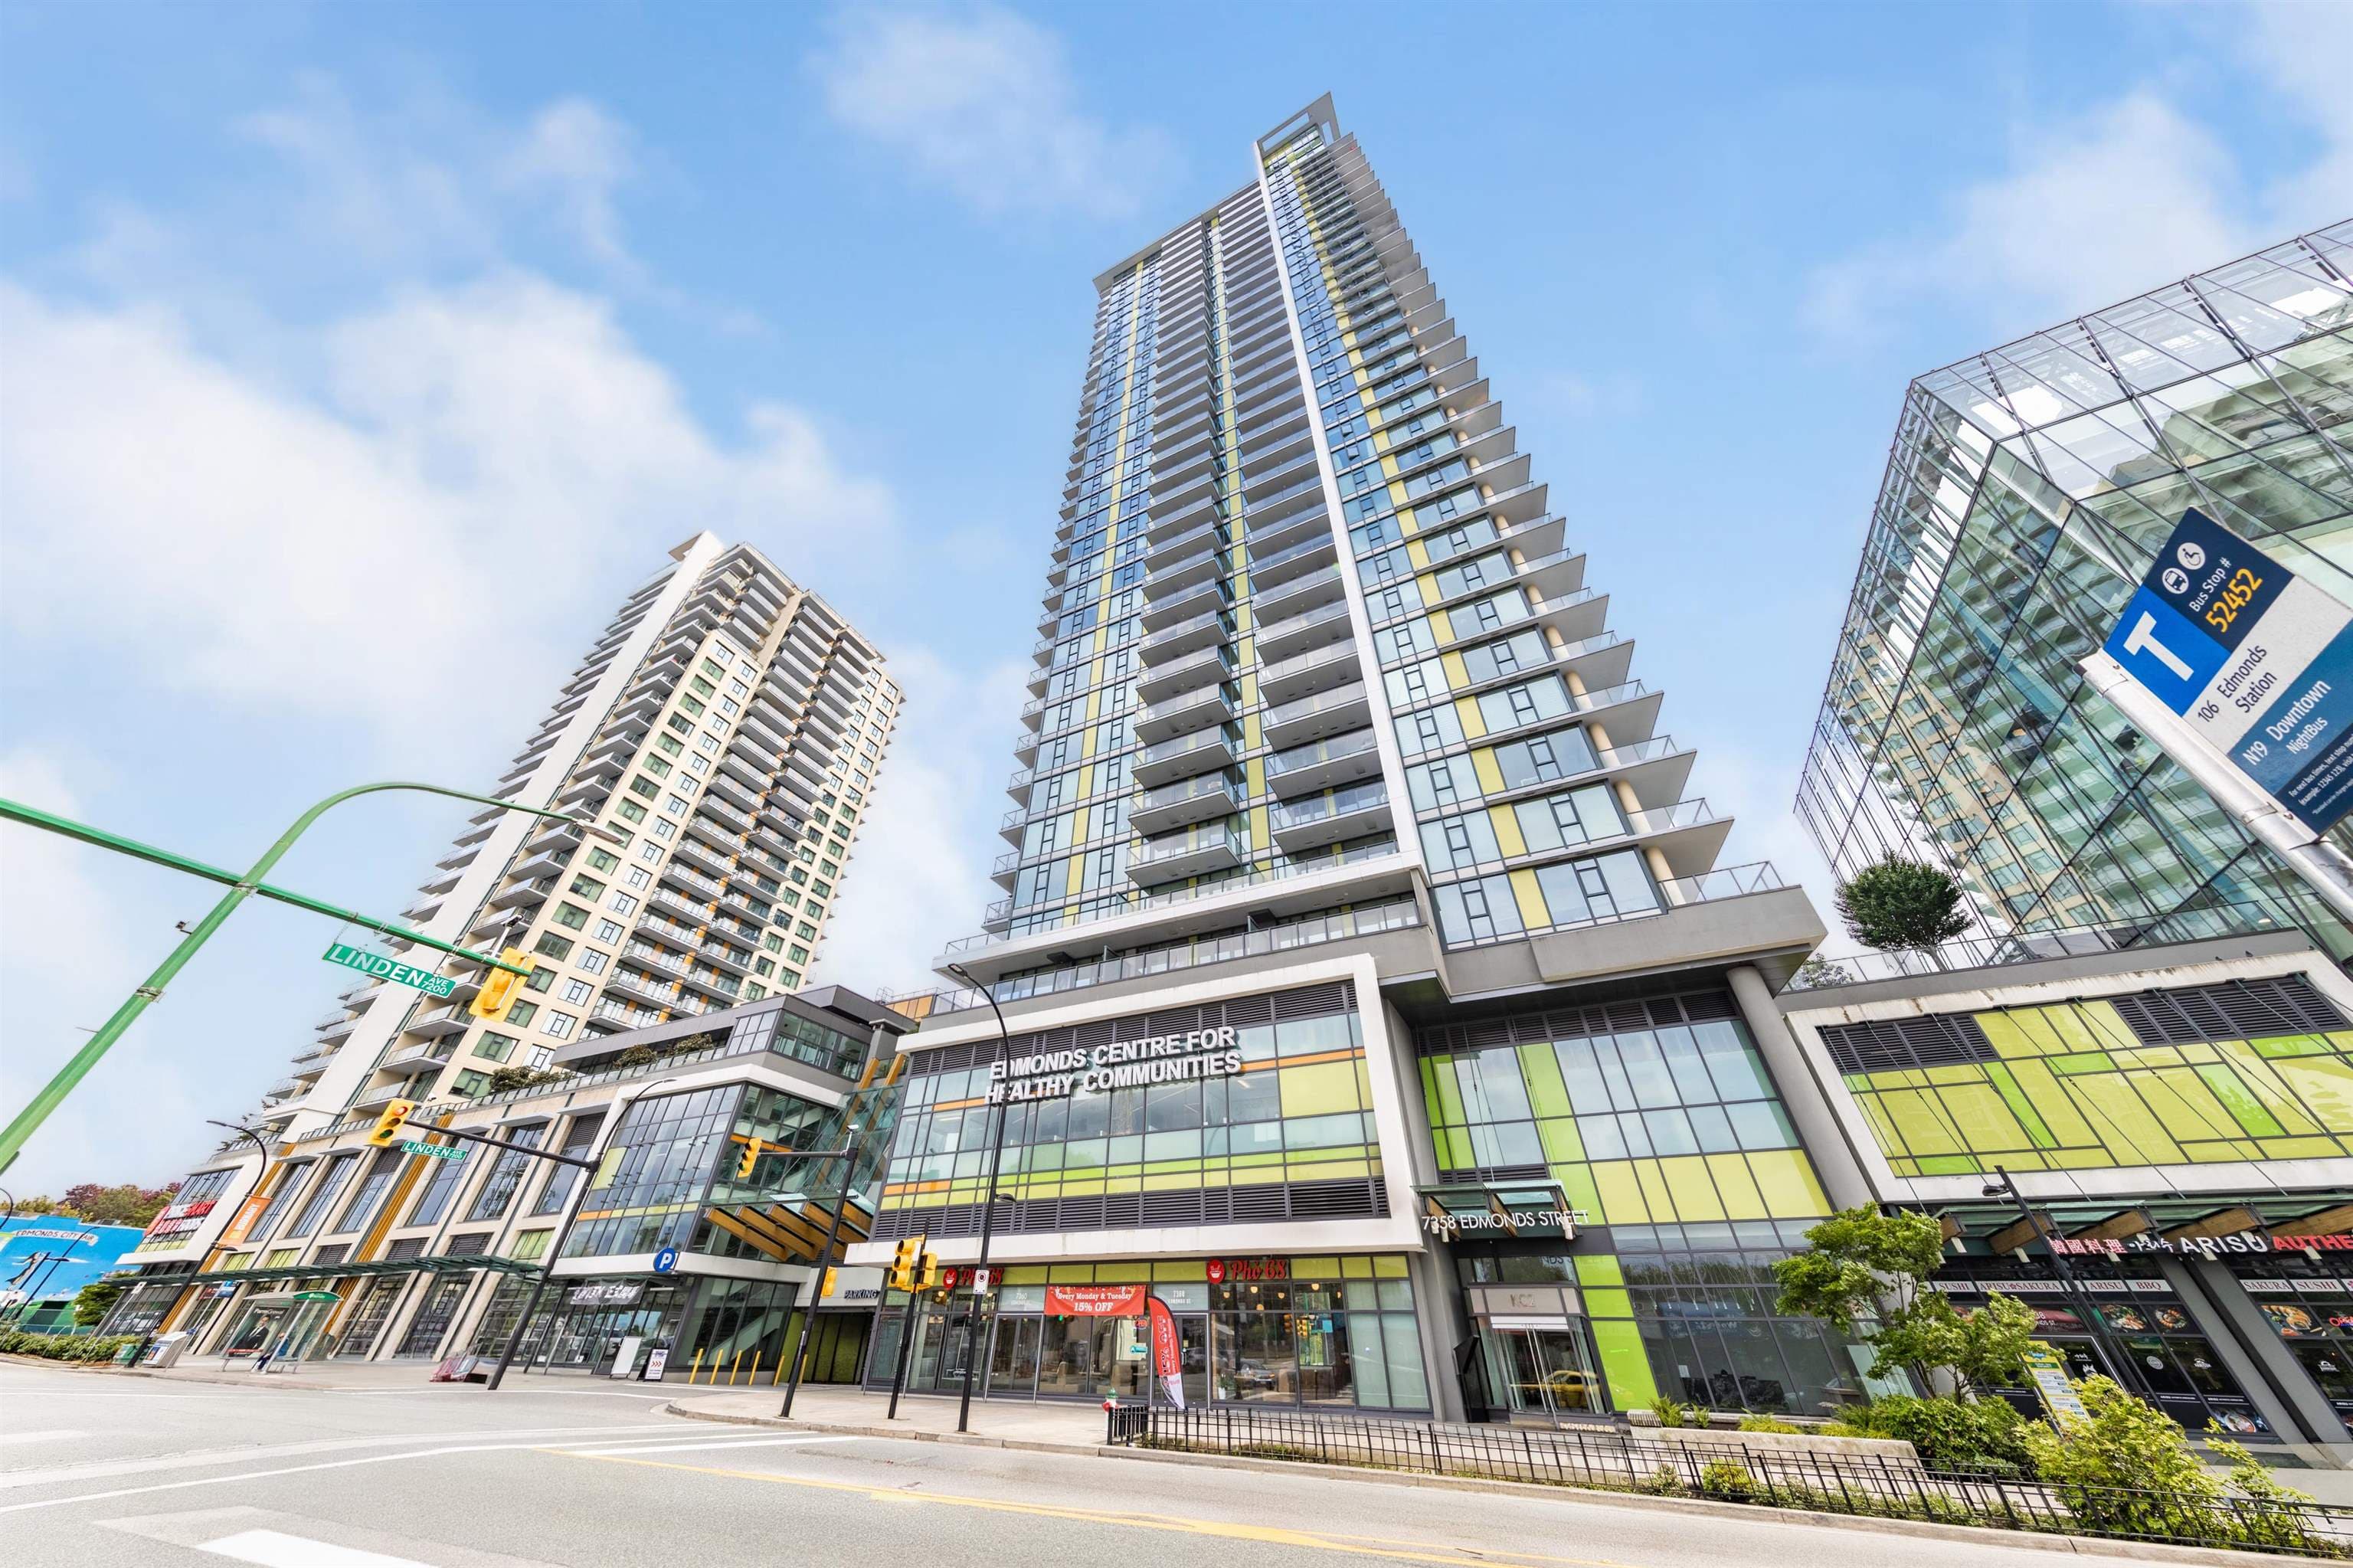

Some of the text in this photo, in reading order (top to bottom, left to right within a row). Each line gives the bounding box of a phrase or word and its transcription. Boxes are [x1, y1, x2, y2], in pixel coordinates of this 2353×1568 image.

[2188, 557, 2231, 612] Bus Stop #
[2206, 568, 2263, 633] 52452
[2123, 610, 2194, 681] T
[2197, 645, 2267, 722] 106 Edmonds
[2235, 672, 2278, 713] Station
[2242, 680, 2332, 766] N19 Downtown
[2286, 716, 2328, 755] NightBus
[2324, 754, 2338, 764] text
[2296, 780, 2309, 791] next
[2302, 774, 2315, 784] bus
[2317, 774, 2334, 789] 12345
[328, 945, 449, 987] LINDEN AVE
[422, 980, 447, 994] 7200
[989, 1026, 1236, 1080] EDMONDS CENTRE FOR
[985, 1052, 1242, 1104] HEALTHY COMMUNITIES
[404, 1142, 451, 1157] LINDEN
[1422, 1210, 1589, 1230] 7358 EDMONDS STREET
[2180, 1236, 2268, 1253] ARISU
[659, 1252, 673, 1269] P
[1265, 1259, 1287, 1280] 68
[843, 1288, 879, 1299] PARKING
[2090, 1282, 2123, 1290] ARISU
[2135, 1282, 2162, 1291] BBQ
[2296, 1281, 2338, 1289] SUSHI
[1058, 1292, 1075, 1301] Every
[1076, 1292, 1100, 1301] Monday
[1108, 1291, 1132, 1301] Tuesday
[1074, 1302, 1114, 1312] 15% OFF
[1157, 1314, 1170, 1373] 15% OFF
